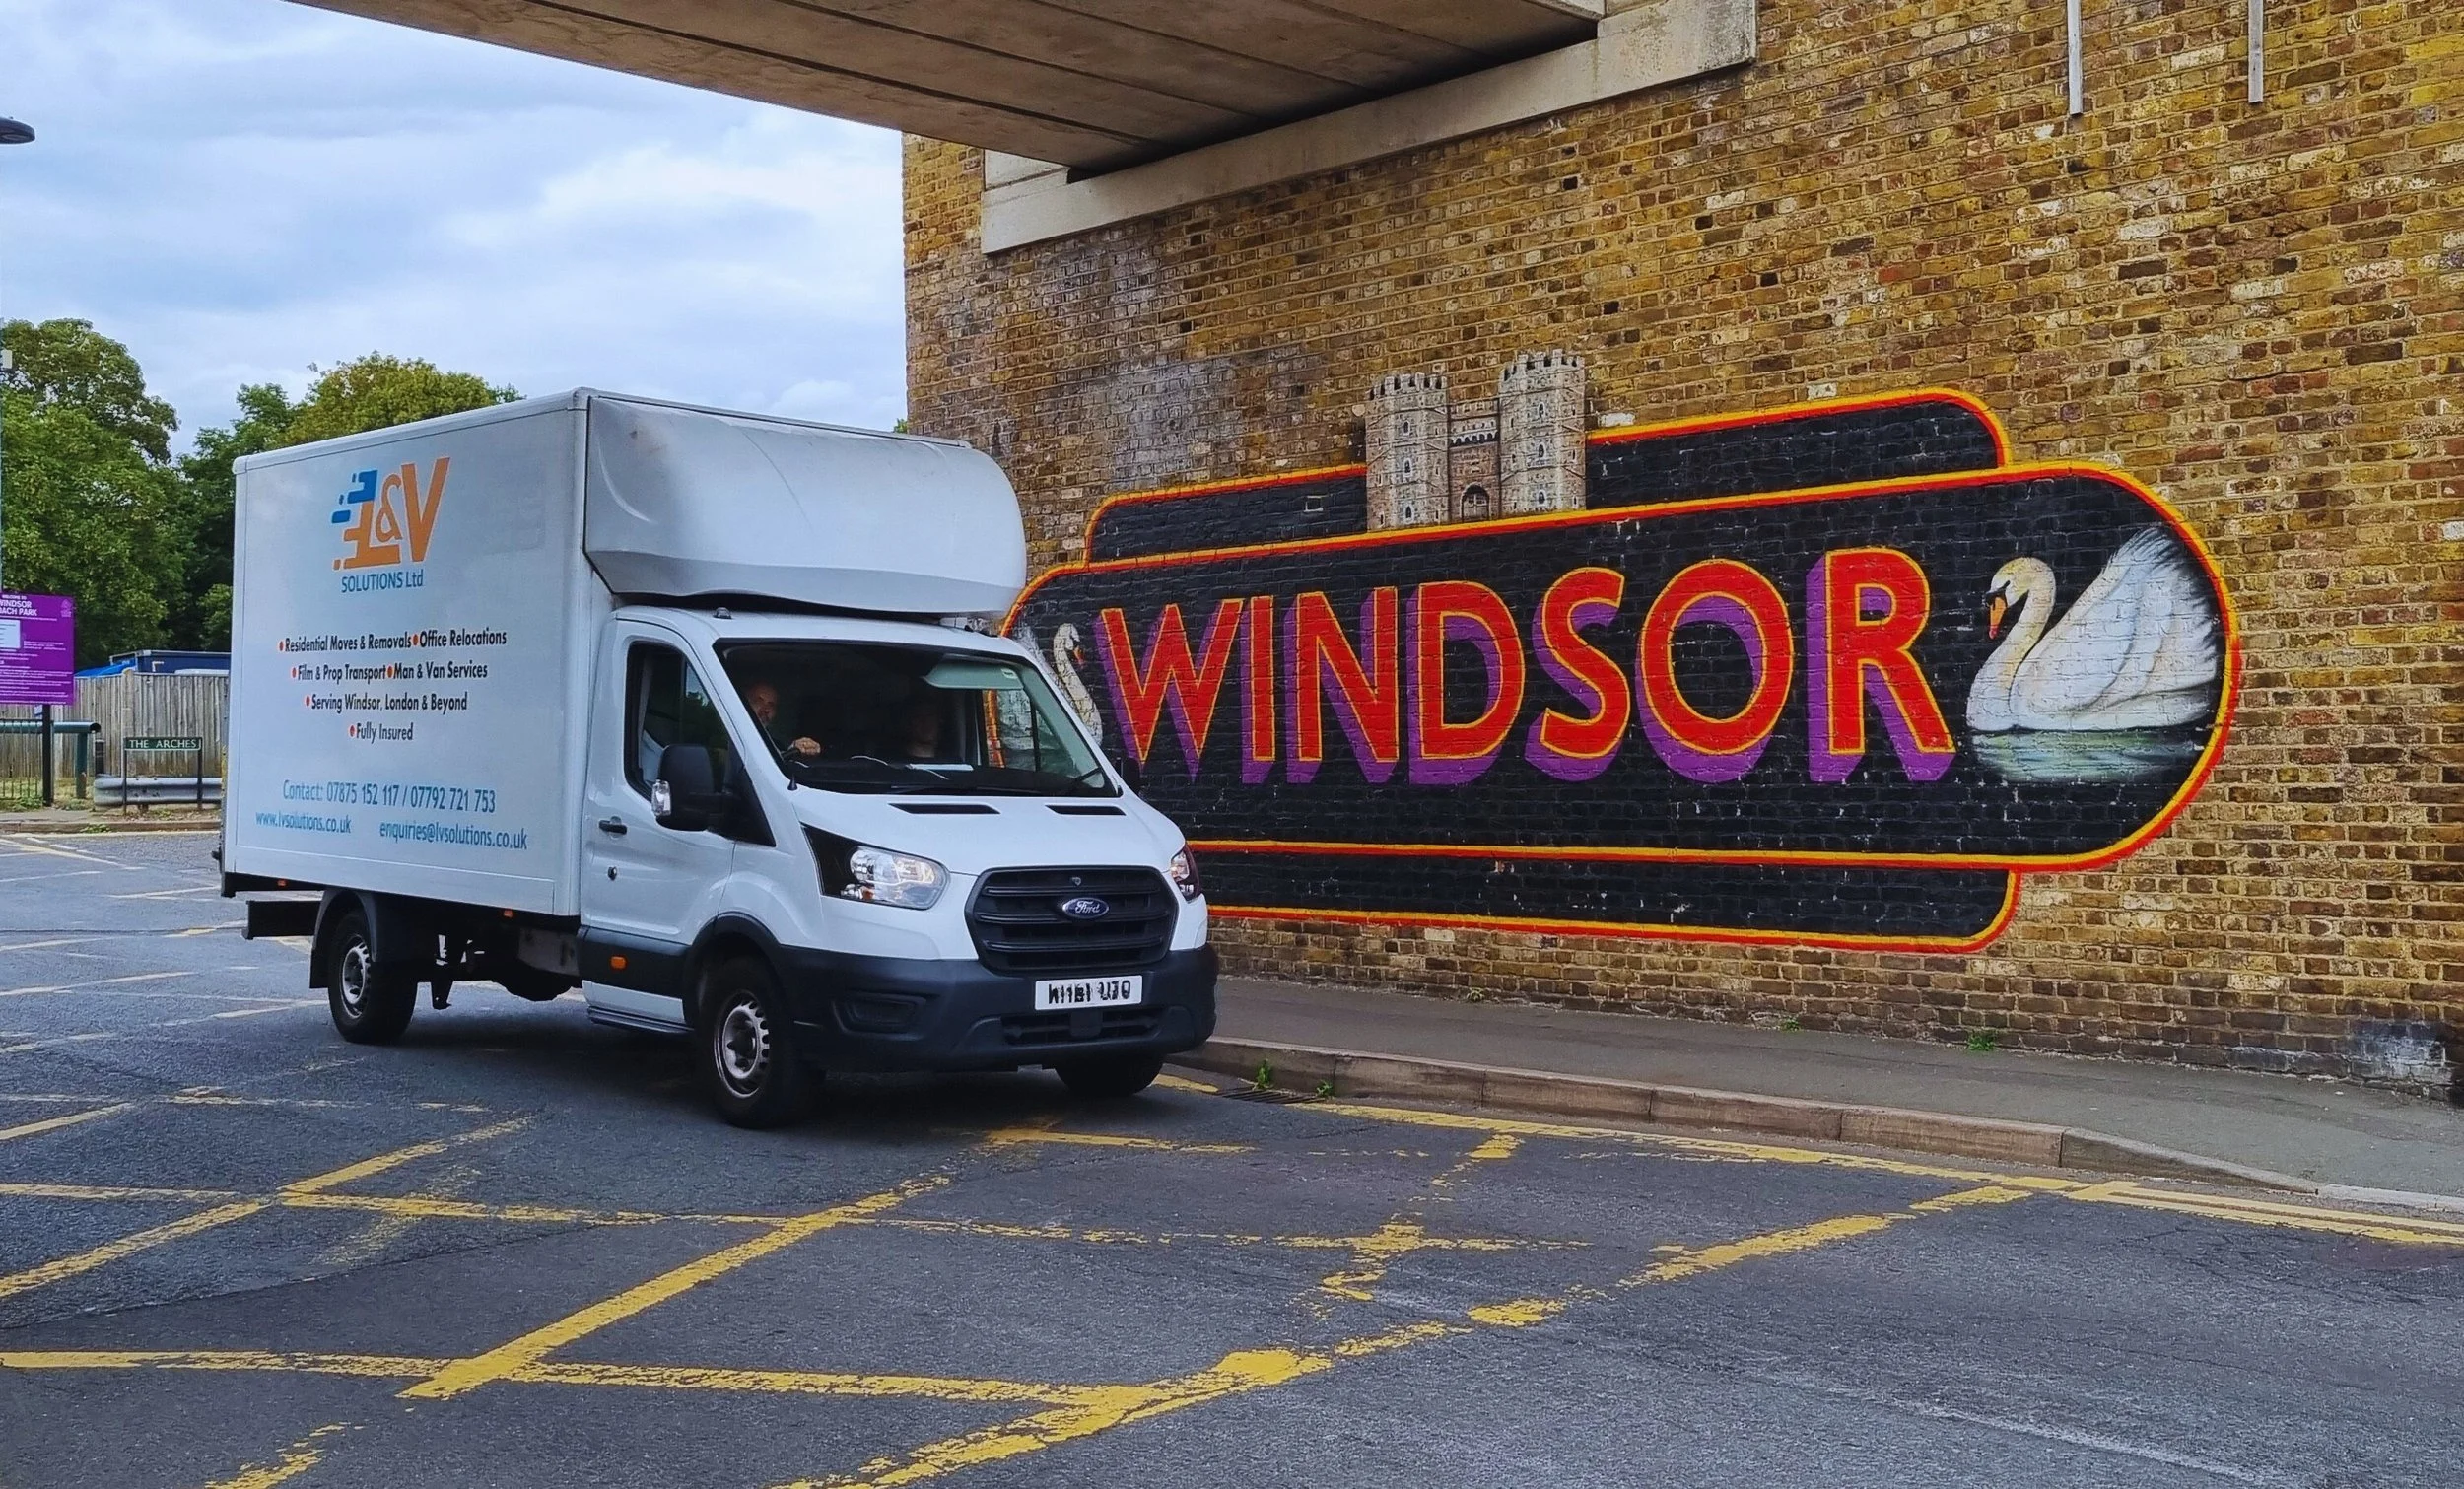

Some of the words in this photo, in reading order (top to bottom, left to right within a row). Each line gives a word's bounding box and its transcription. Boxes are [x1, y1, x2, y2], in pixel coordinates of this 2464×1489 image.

[341, 571, 403, 593] SOLUTIONS
[405, 569, 424, 588] Ltd
[285, 635, 328, 652] Residential
[330, 635, 358, 651] Moves
[360, 635, 366, 650] &
[368, 631, 412, 650] Removals
[419, 629, 447, 648] Office
[449, 627, 507, 647] Relocations
[298, 664, 313, 681] Film
[315, 666, 321, 680] &
[323, 664, 343, 685] Prop
[345, 663, 386, 685] Transport
[393, 662, 414, 680] Man
[417, 663, 423, 679] &
[426, 661, 445, 679] Van
[447, 659, 488, 679] Services
[1091, 546, 1957, 786] WINDSOR
[311, 693, 343, 714] Serving
[345, 692, 383, 711] Windsor,
[385, 692, 419, 711] London
[421, 694, 428, 711] &
[431, 691, 468, 715] Beyond
[129, 739, 149, 749] THE
[156, 739, 197, 749] ARCHES
[356, 721, 377, 745] Fully
[379, 721, 414, 741] Insured
[283, 779, 323, 801] Contact:
[326, 781, 358, 804] 07875
[362, 783, 378, 805] 152
[383, 784, 400, 806] 117
[402, 786, 408, 807] /
[410, 786, 445, 810] 07792
[449, 787, 469, 811] 721
[474, 789, 496, 813] 753
[255, 811, 351, 834] www.lvsolutions.co.uk
[379, 821, 528, 849] enquiries@lvsolutions.co.uk
[1074, 899, 1100, 914] Ford
